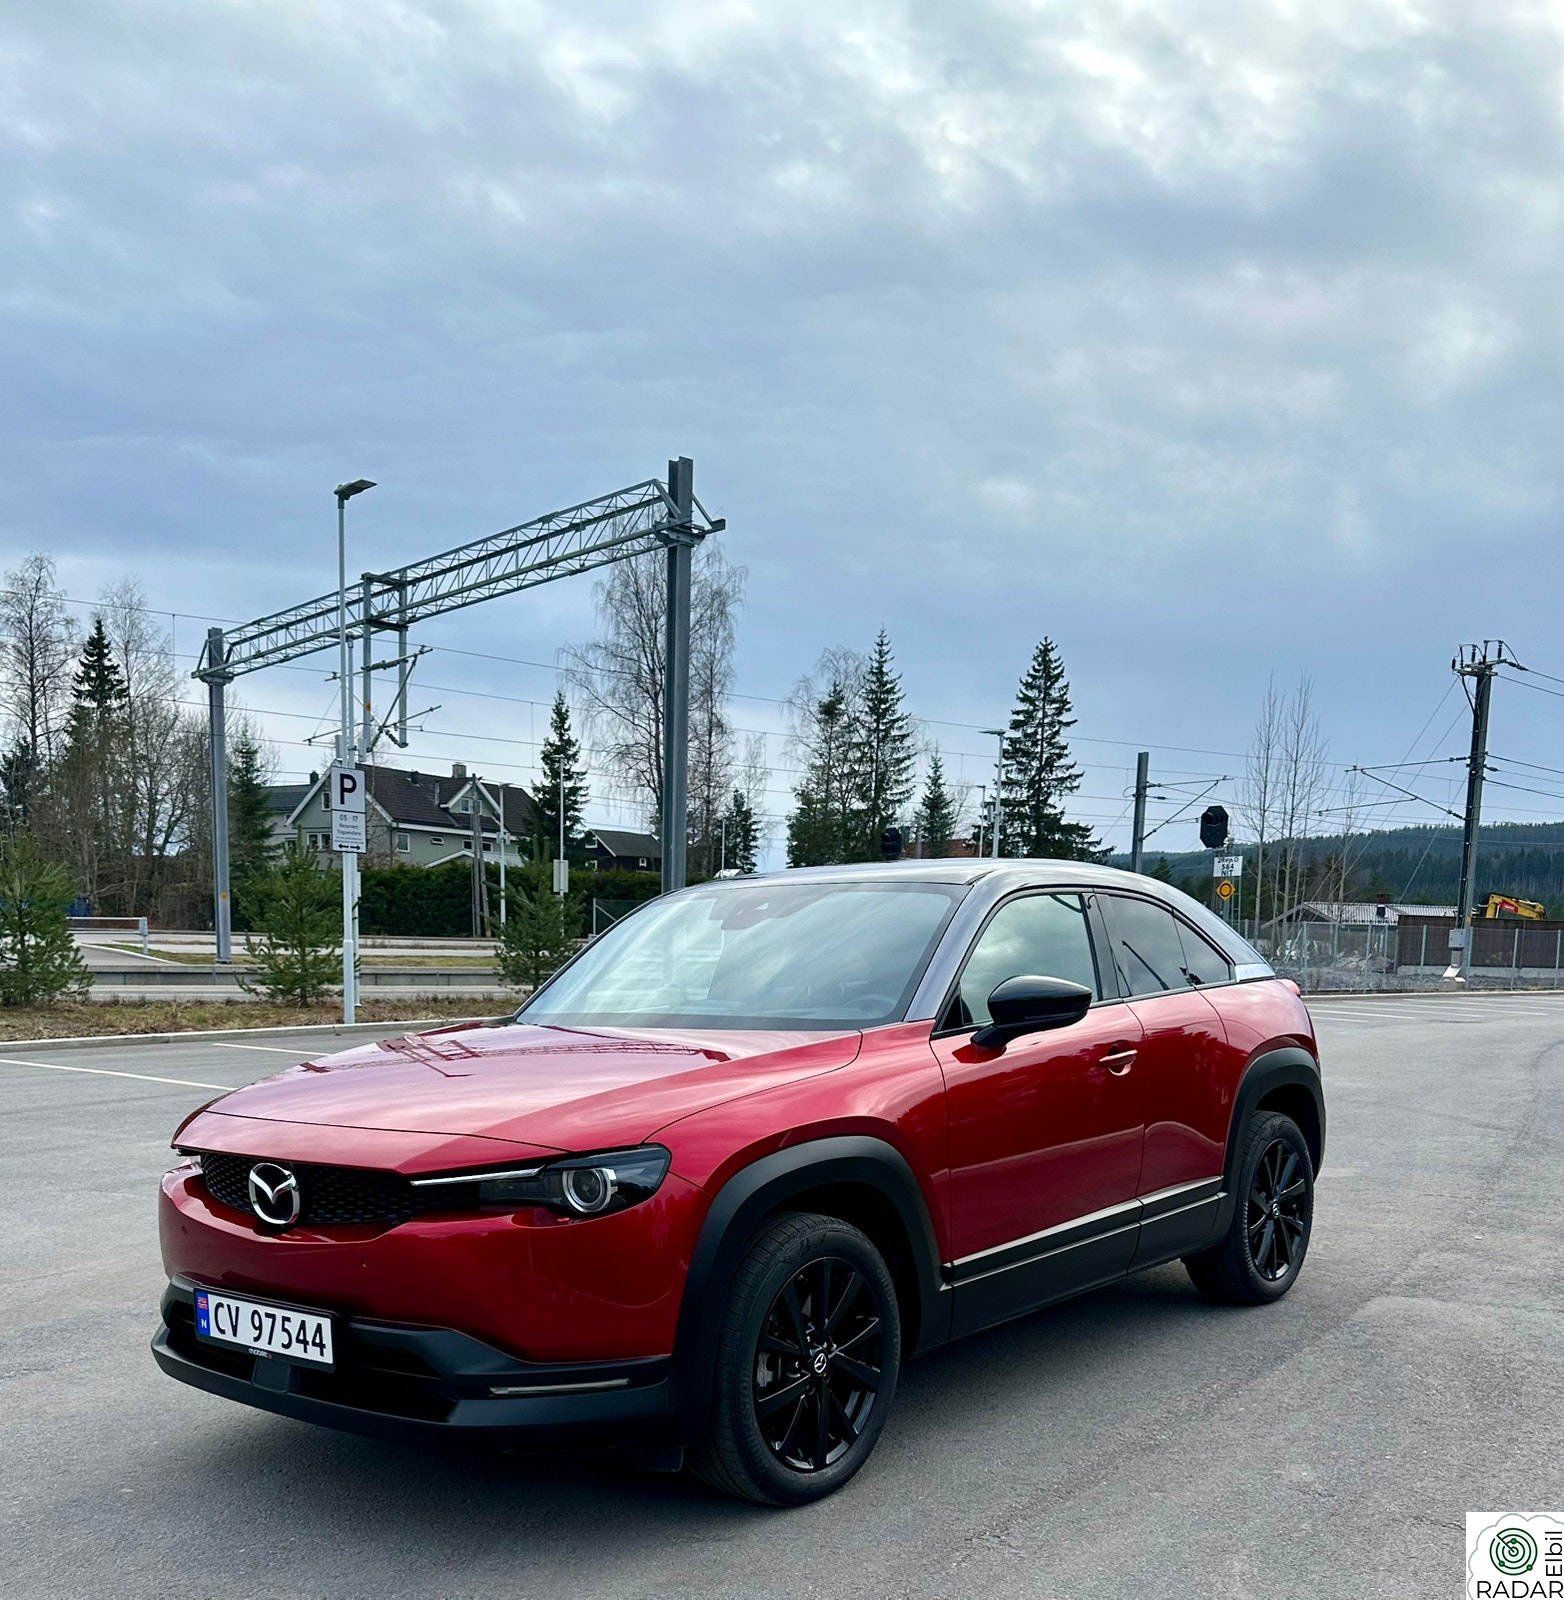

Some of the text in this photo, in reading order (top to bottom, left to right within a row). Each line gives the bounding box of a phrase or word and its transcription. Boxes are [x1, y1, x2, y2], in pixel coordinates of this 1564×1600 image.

[339, 773, 357, 805] P
[201, 1318, 207, 1329] N
[214, 1302, 326, 1357] CV 97544
